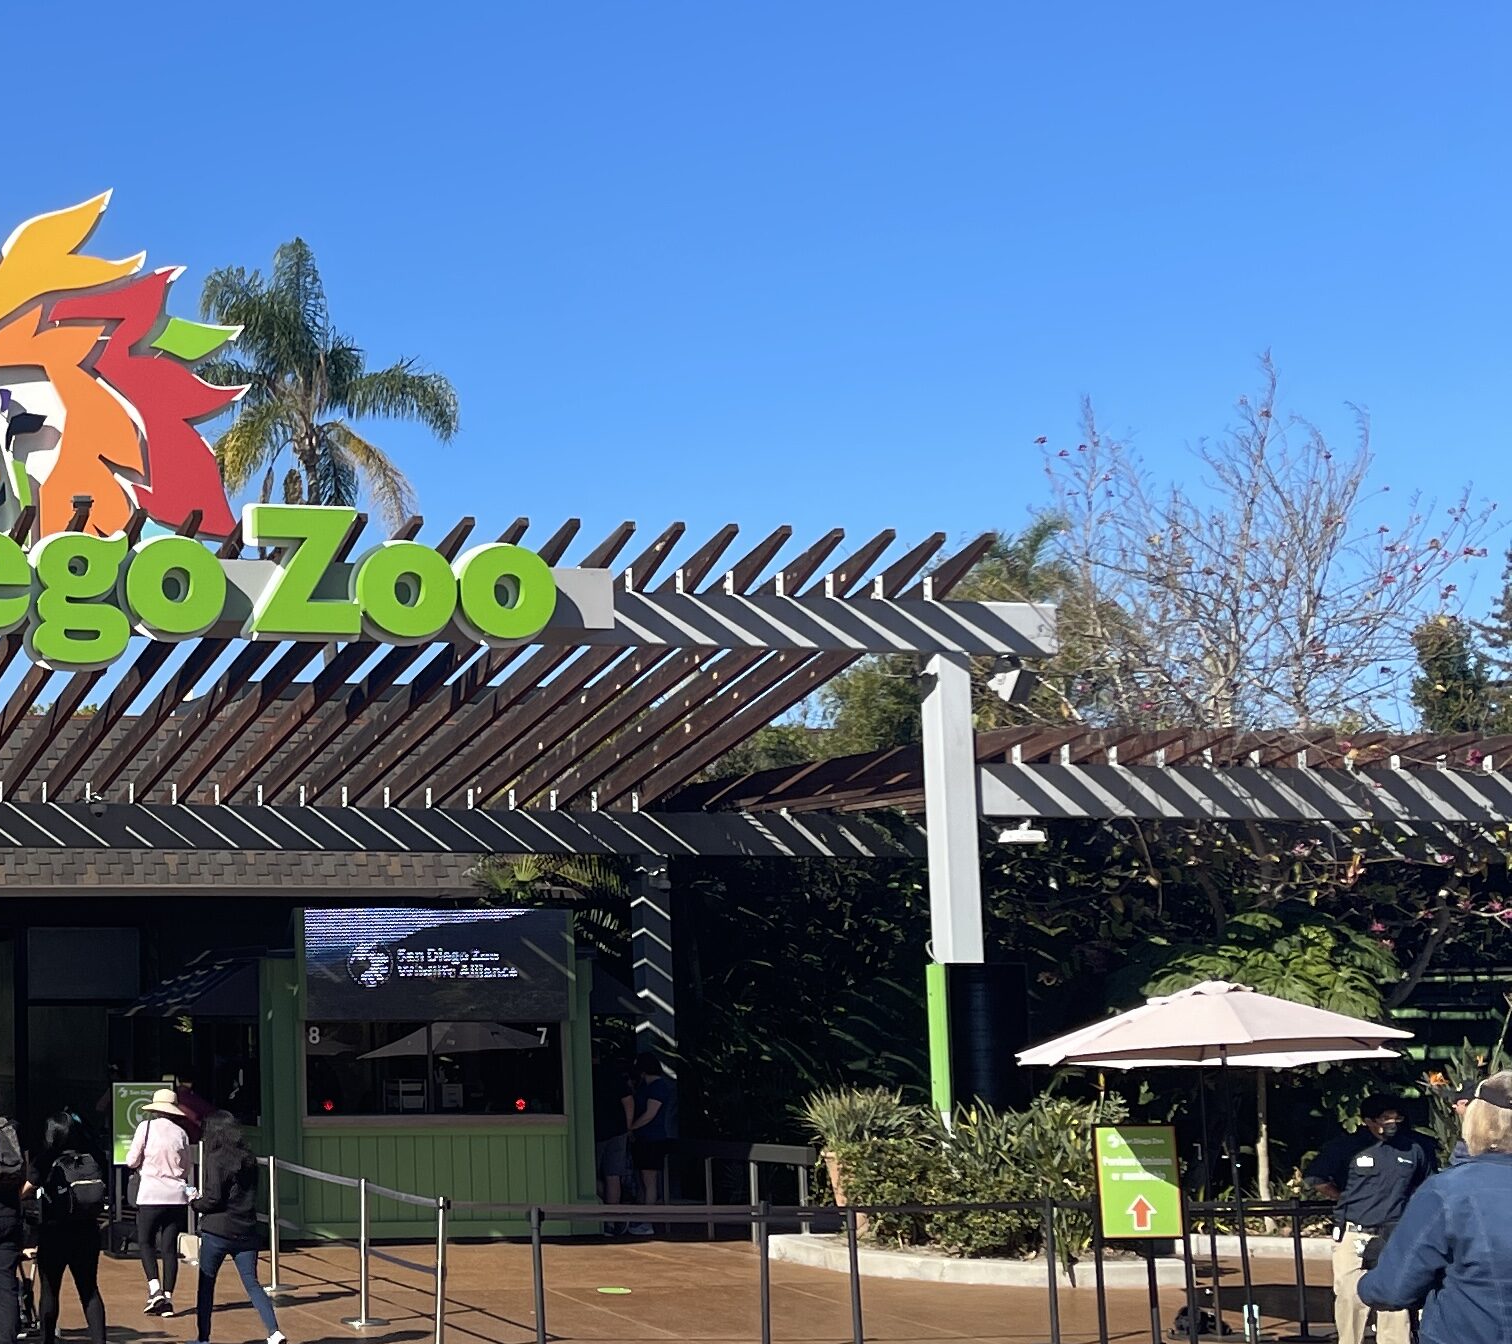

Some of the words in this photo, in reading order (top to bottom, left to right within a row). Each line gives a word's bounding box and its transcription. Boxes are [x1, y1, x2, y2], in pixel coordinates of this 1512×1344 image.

[241, 503, 558, 648] Zoo
[397, 948, 425, 962] San
[427, 947, 469, 965] Diego
[459, 964, 519, 978] Alliance
[308, 1027, 320, 1044] 8
[537, 1027, 548, 1045] 7
